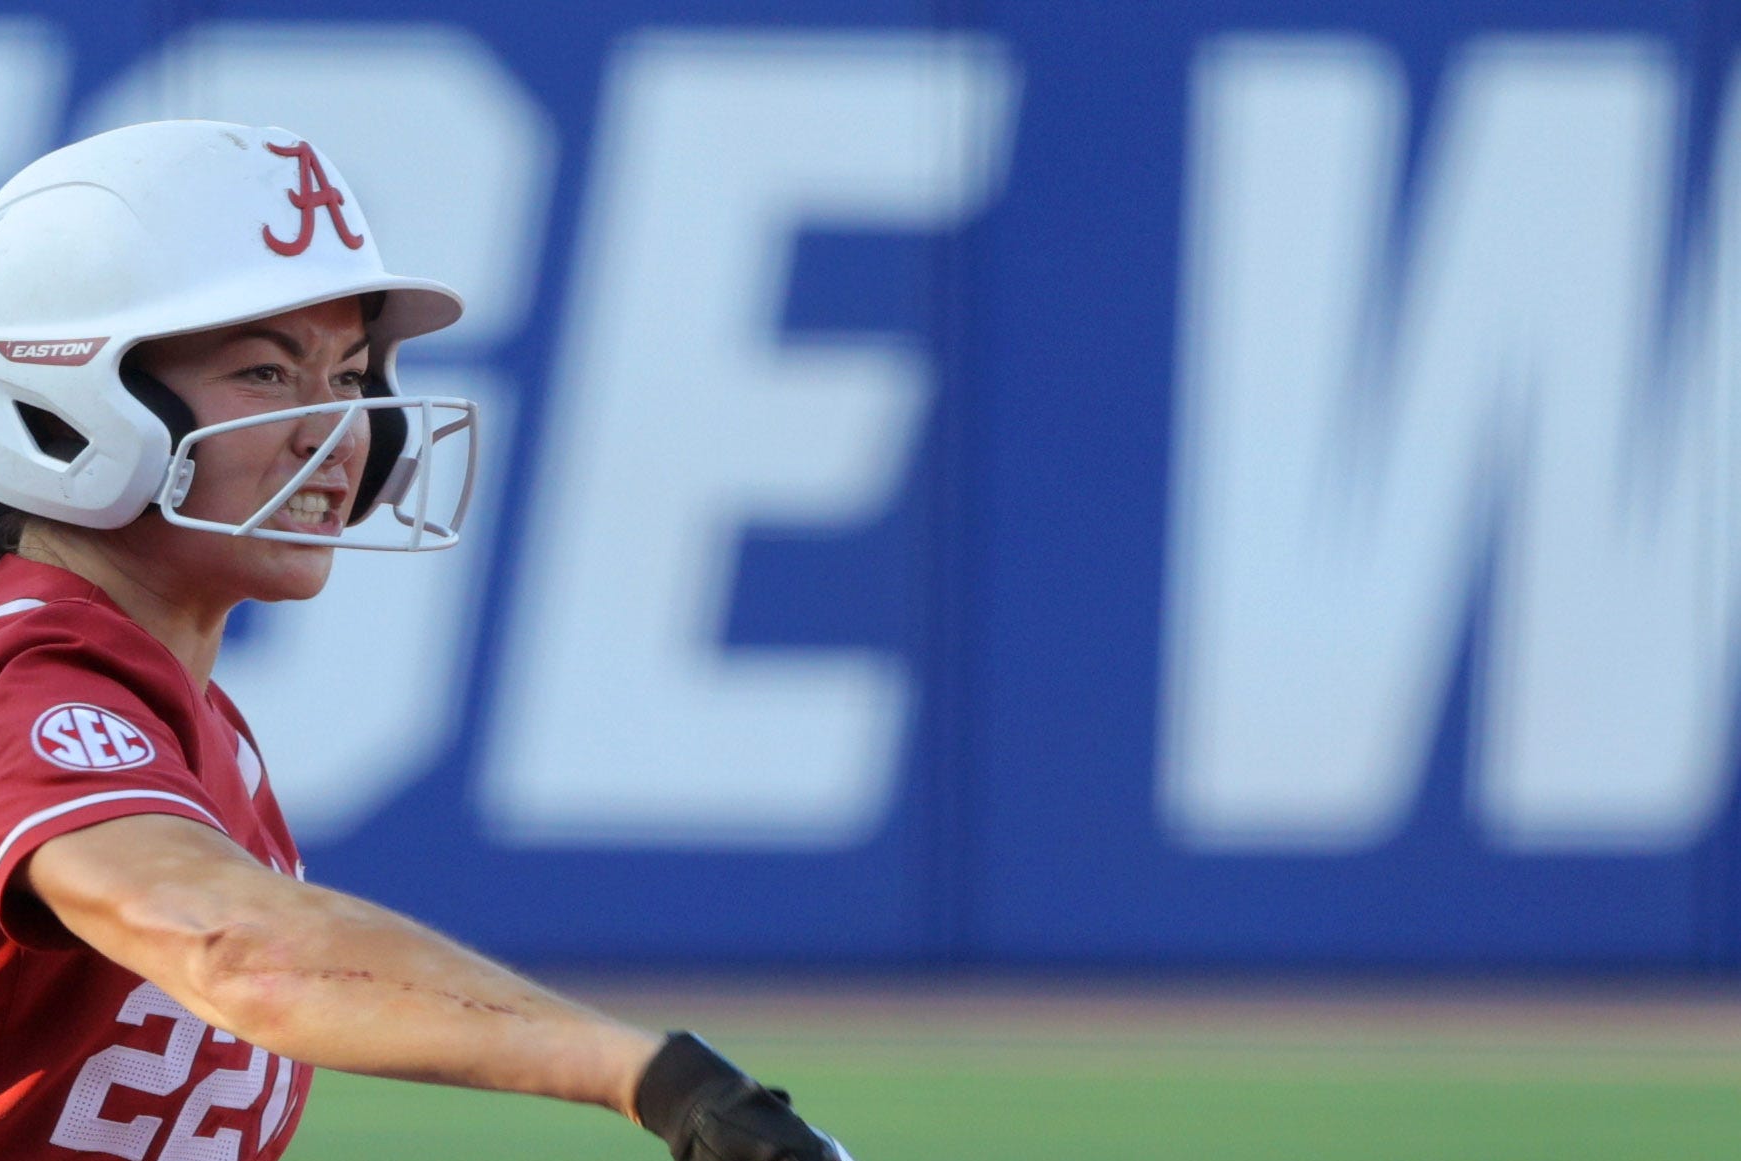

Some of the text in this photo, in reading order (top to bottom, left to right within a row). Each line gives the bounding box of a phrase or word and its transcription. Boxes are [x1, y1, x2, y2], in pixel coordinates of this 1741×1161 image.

[262, 140, 365, 257] A
[11, 341, 94, 359] EASTON
[40, 707, 149, 768] SEC
